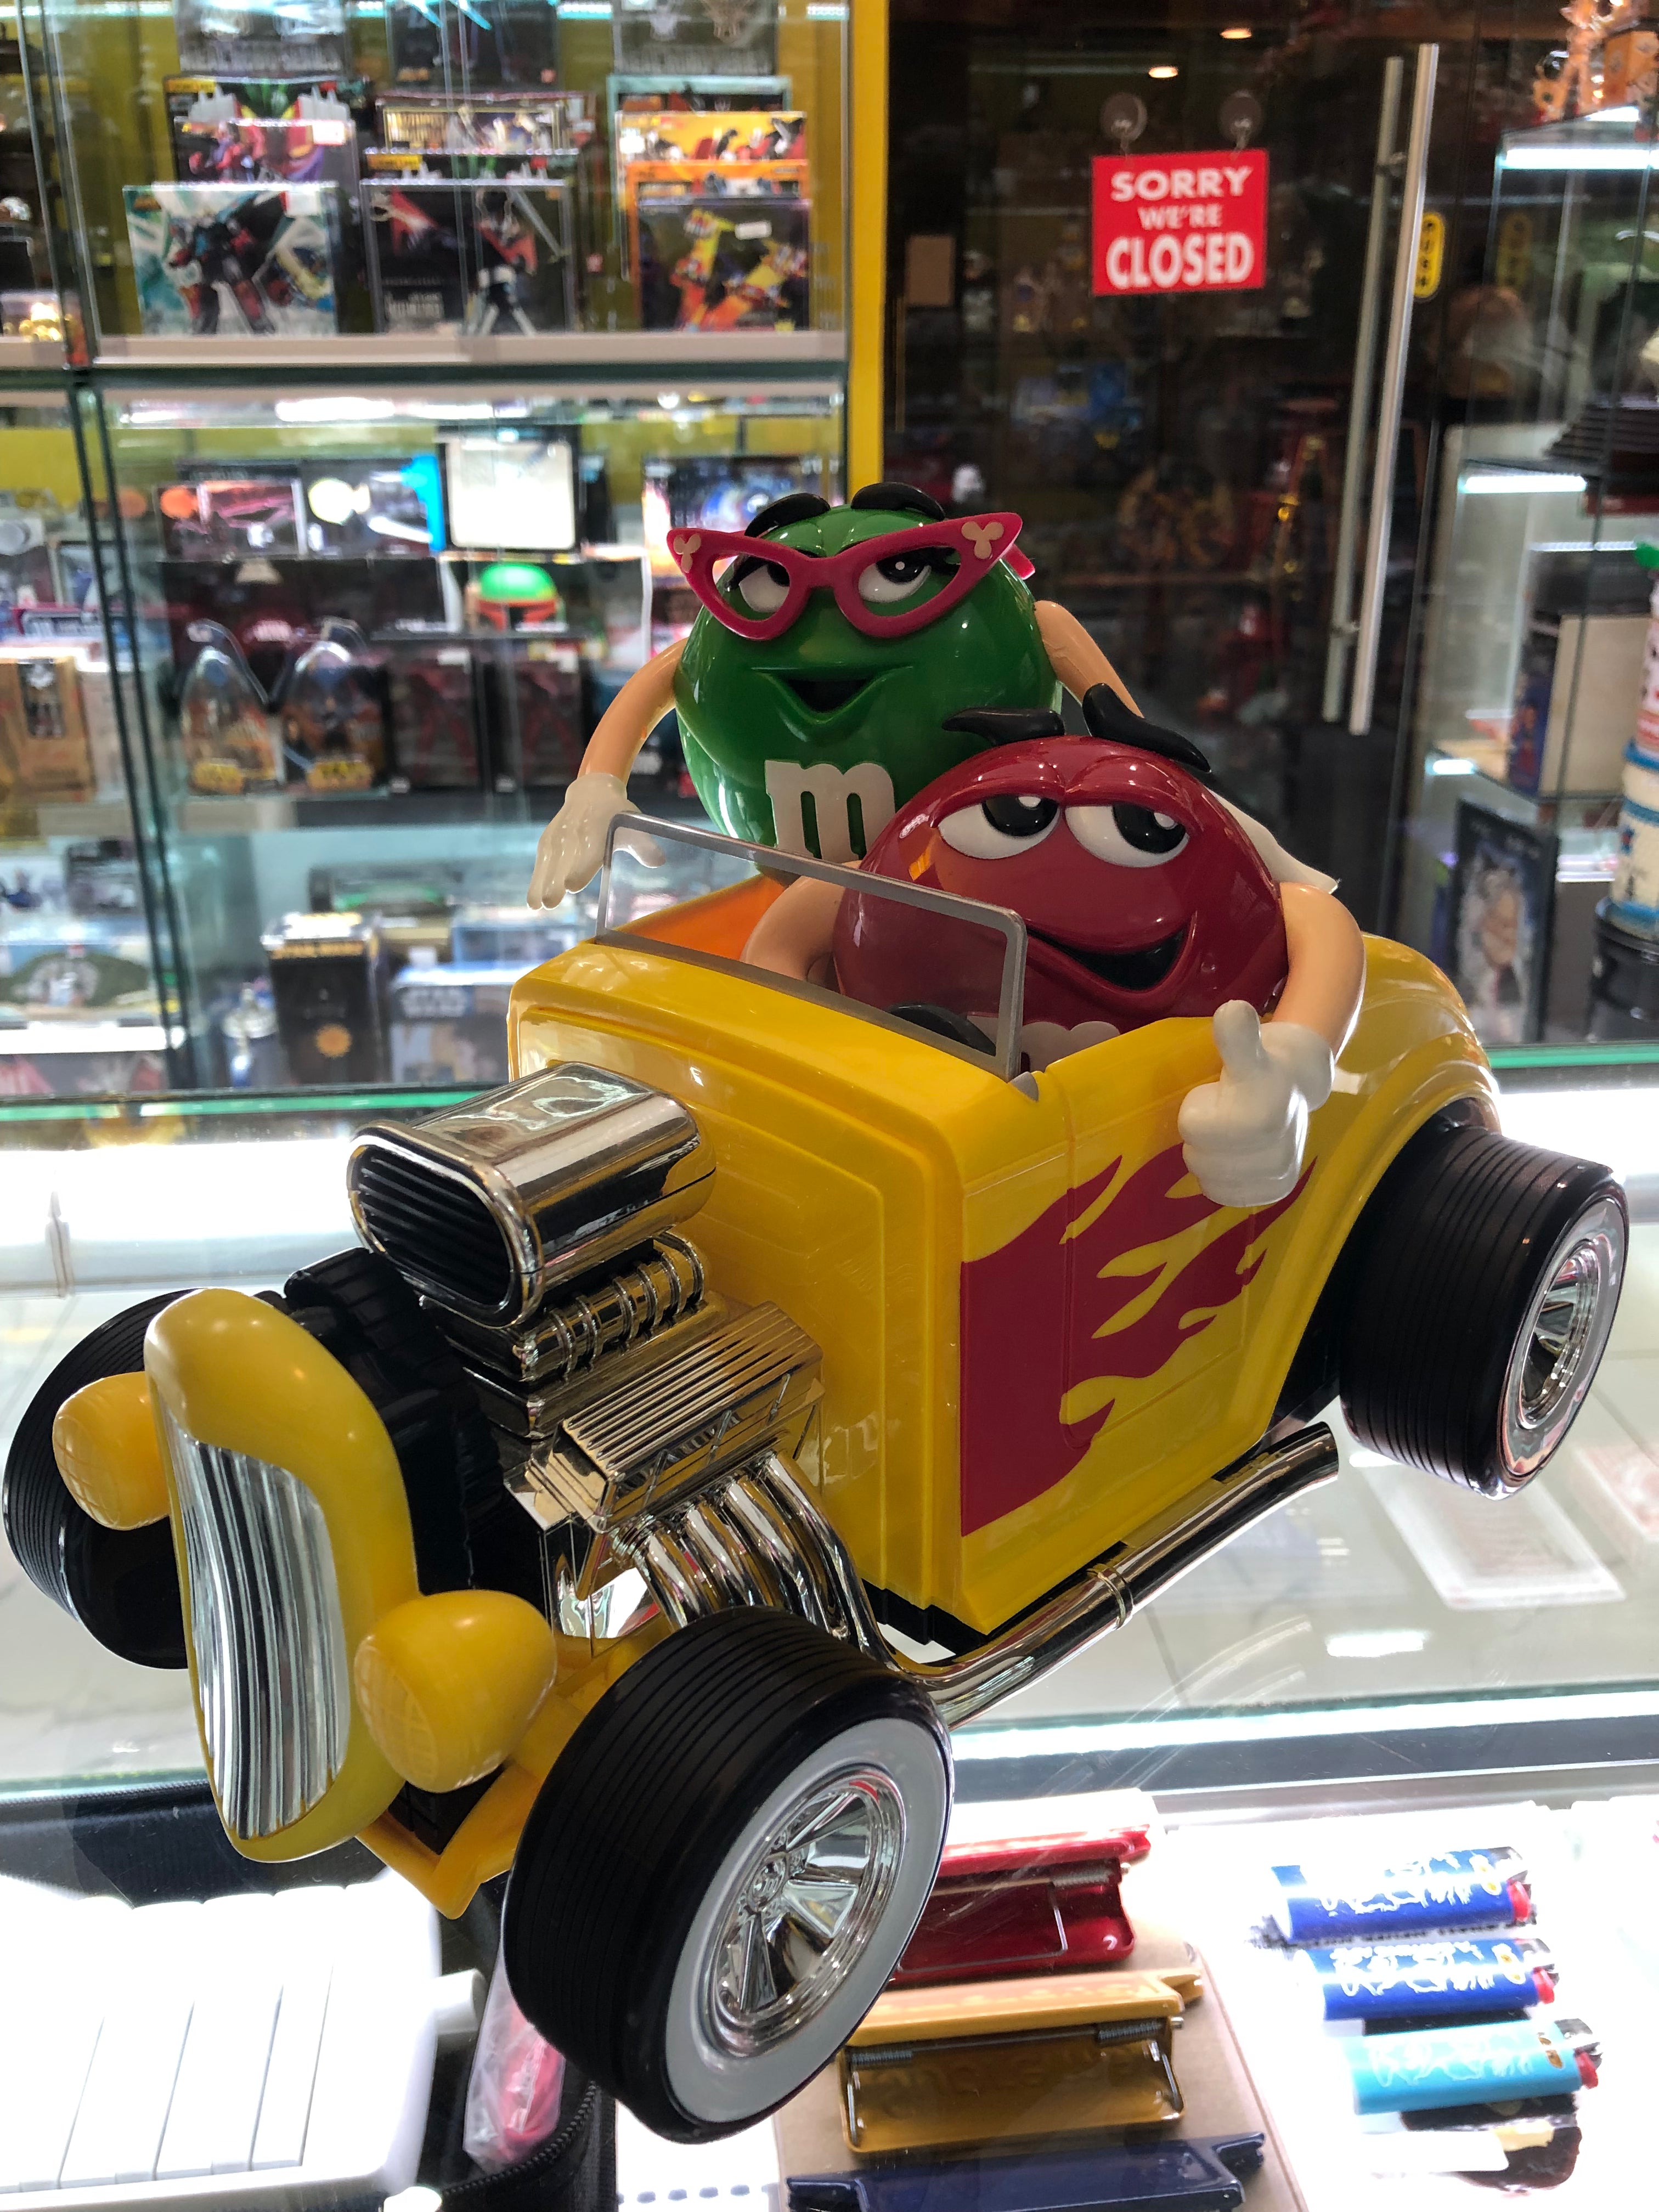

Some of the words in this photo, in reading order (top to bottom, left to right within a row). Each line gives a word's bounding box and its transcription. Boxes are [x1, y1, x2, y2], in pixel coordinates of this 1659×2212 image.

[1110, 166, 1253, 202] SORRY
[1138, 203, 1223, 230] WE'RE
[1106, 232, 1254, 289] CLOSED
[764, 760, 896, 864] m
